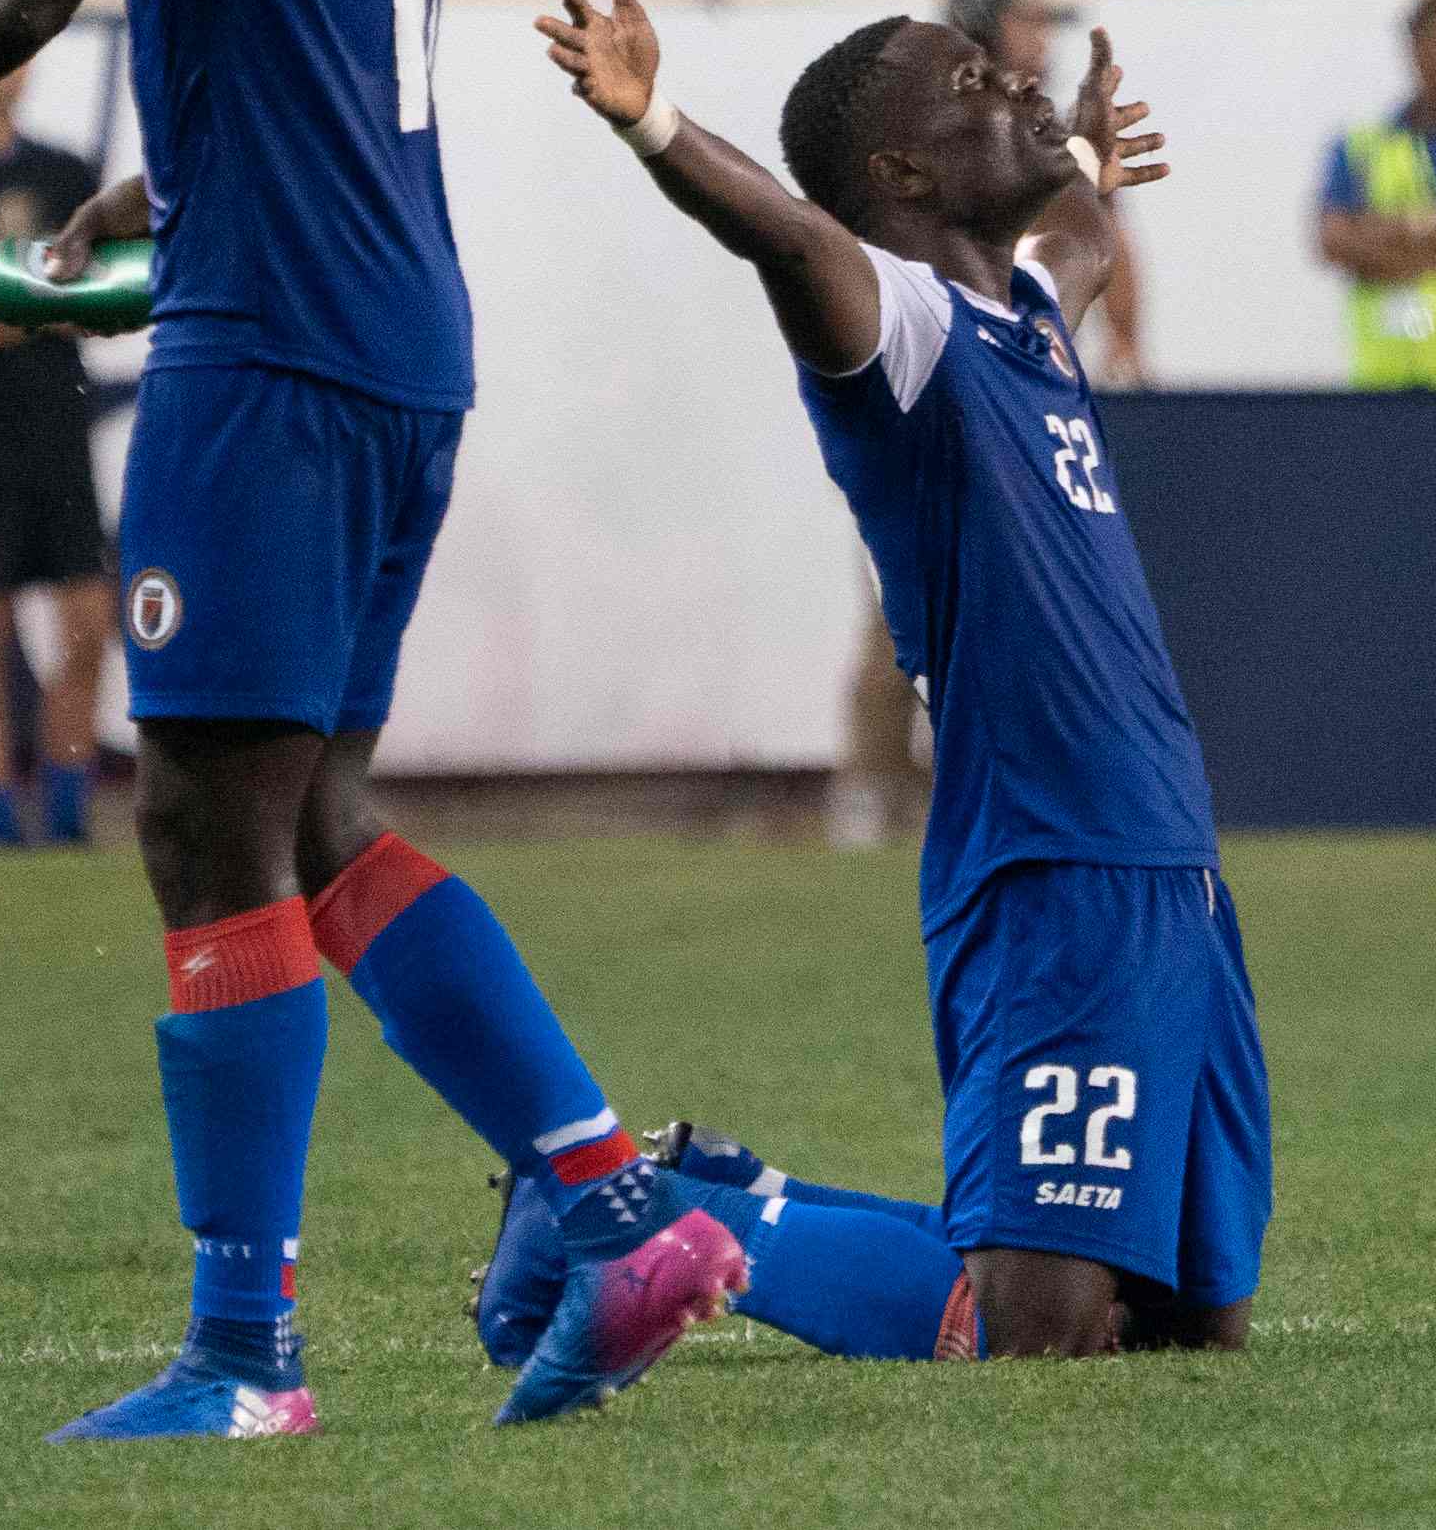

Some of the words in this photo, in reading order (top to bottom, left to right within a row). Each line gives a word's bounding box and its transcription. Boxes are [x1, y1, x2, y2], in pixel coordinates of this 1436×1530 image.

[1045, 414, 1116, 514] 22
[1020, 1064, 1137, 1170] 22
[1035, 1181, 1123, 1211] SAETA
